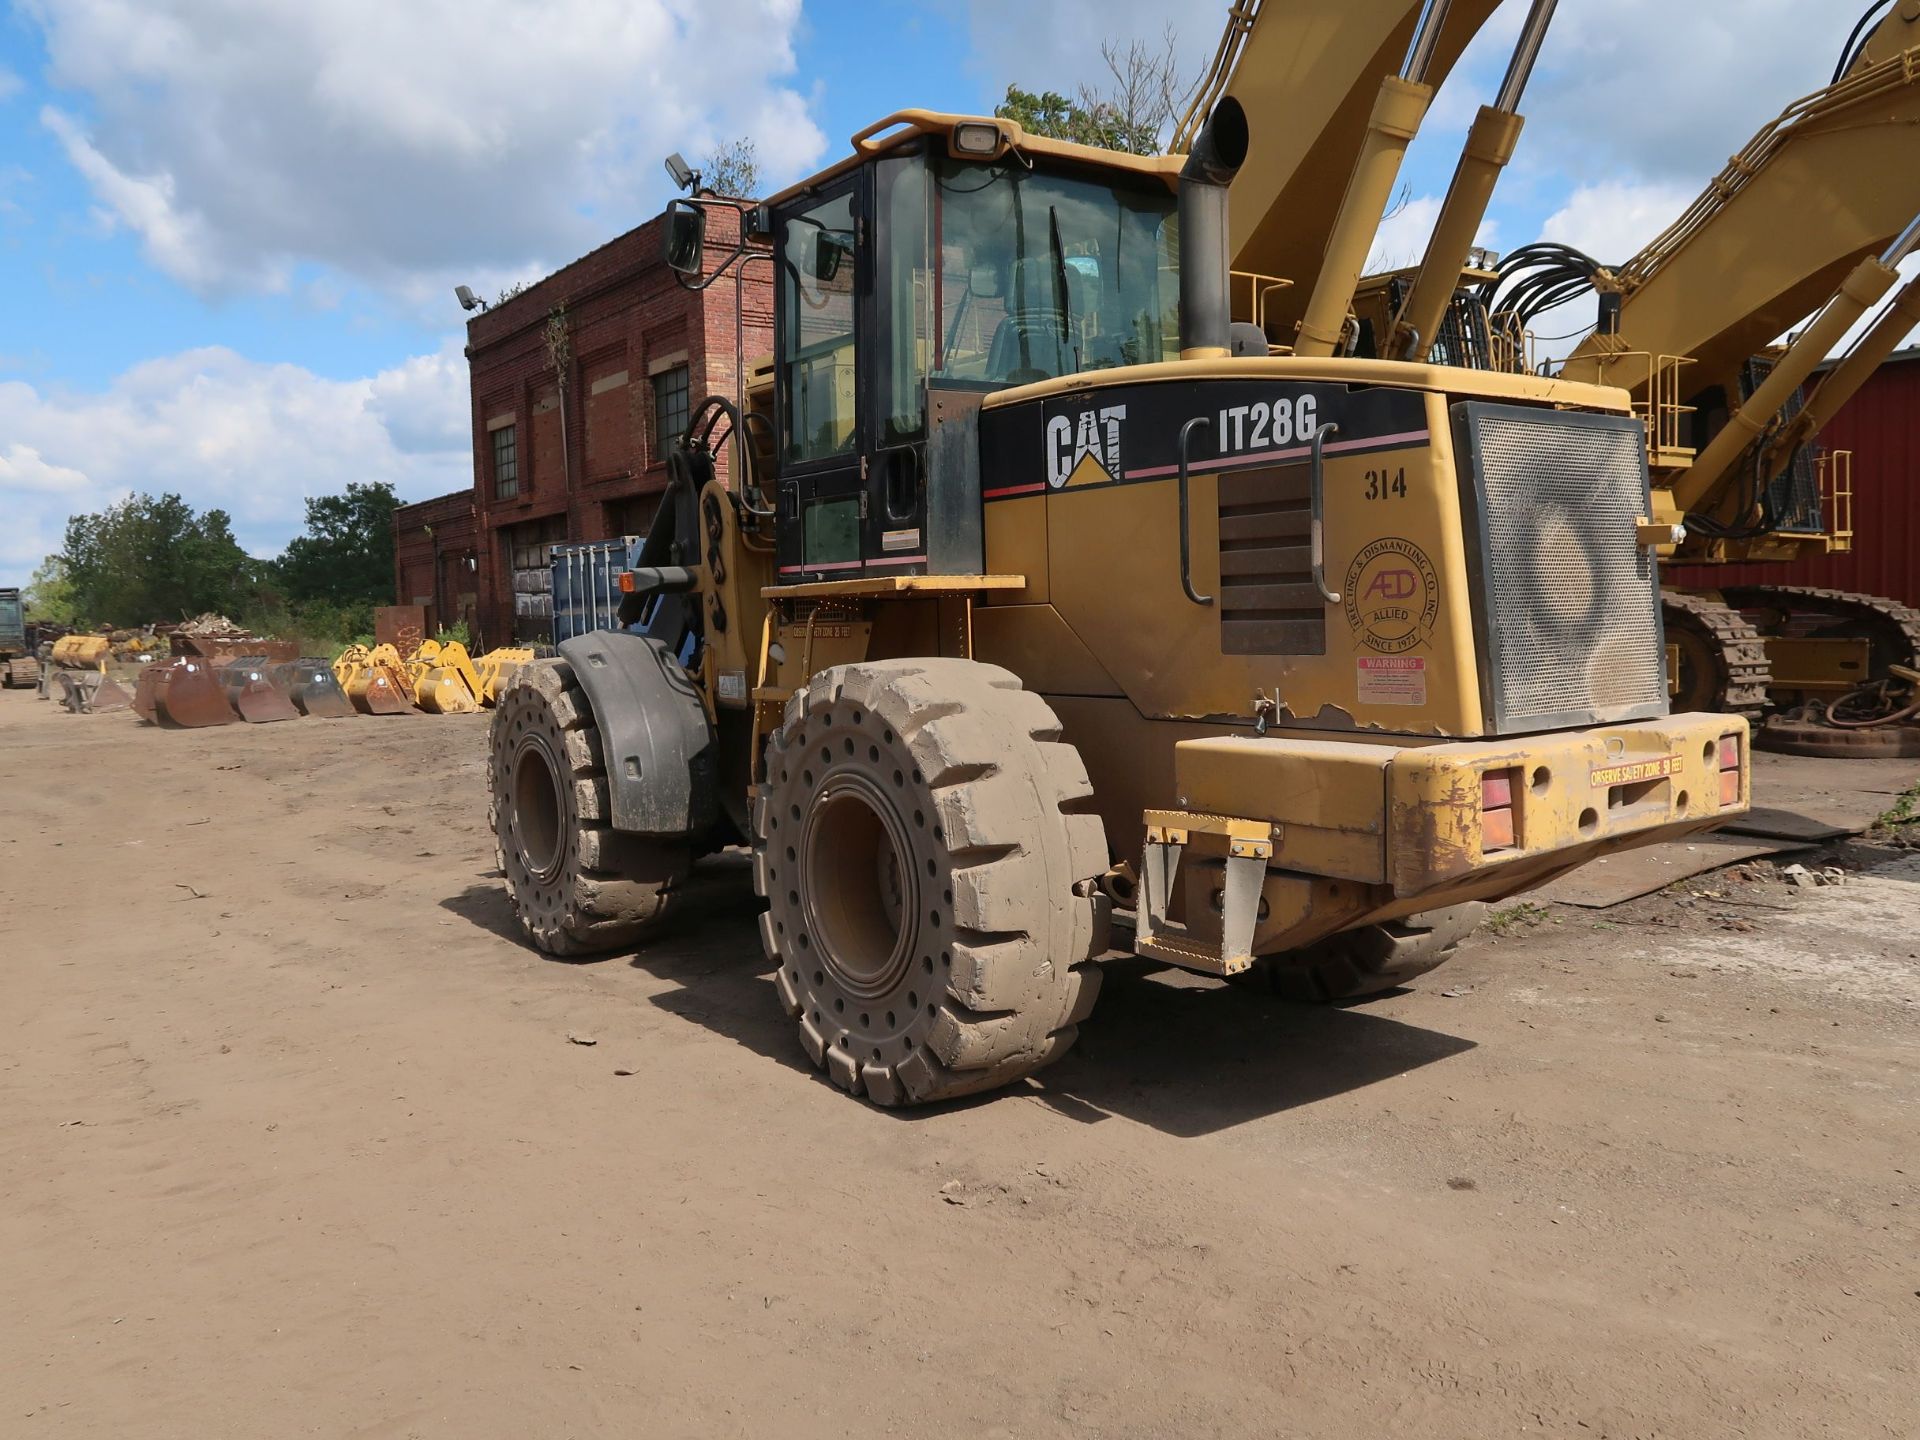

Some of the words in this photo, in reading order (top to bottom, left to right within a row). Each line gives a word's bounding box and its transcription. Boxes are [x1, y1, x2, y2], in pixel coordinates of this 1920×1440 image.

[1219, 393, 1317, 453] IT28G
[1047, 404, 1126, 489] CAT
[1364, 468, 1407, 500] 314
[1346, 570, 1360, 627] ERECTING
[1356, 560, 1363, 569] &
[1364, 541, 1428, 569] DISMANTLING
[1425, 572, 1436, 594] CO.
[1374, 609, 1409, 621] ALLIED
[1366, 634, 1393, 651] SINCE
[1397, 633, 1417, 650] 1973
[1366, 658, 1417, 669] WARNING
[1591, 767, 1621, 786] OBSERVE
[1644, 761, 1661, 778] ZONE
[1671, 757, 1682, 772] FEET
